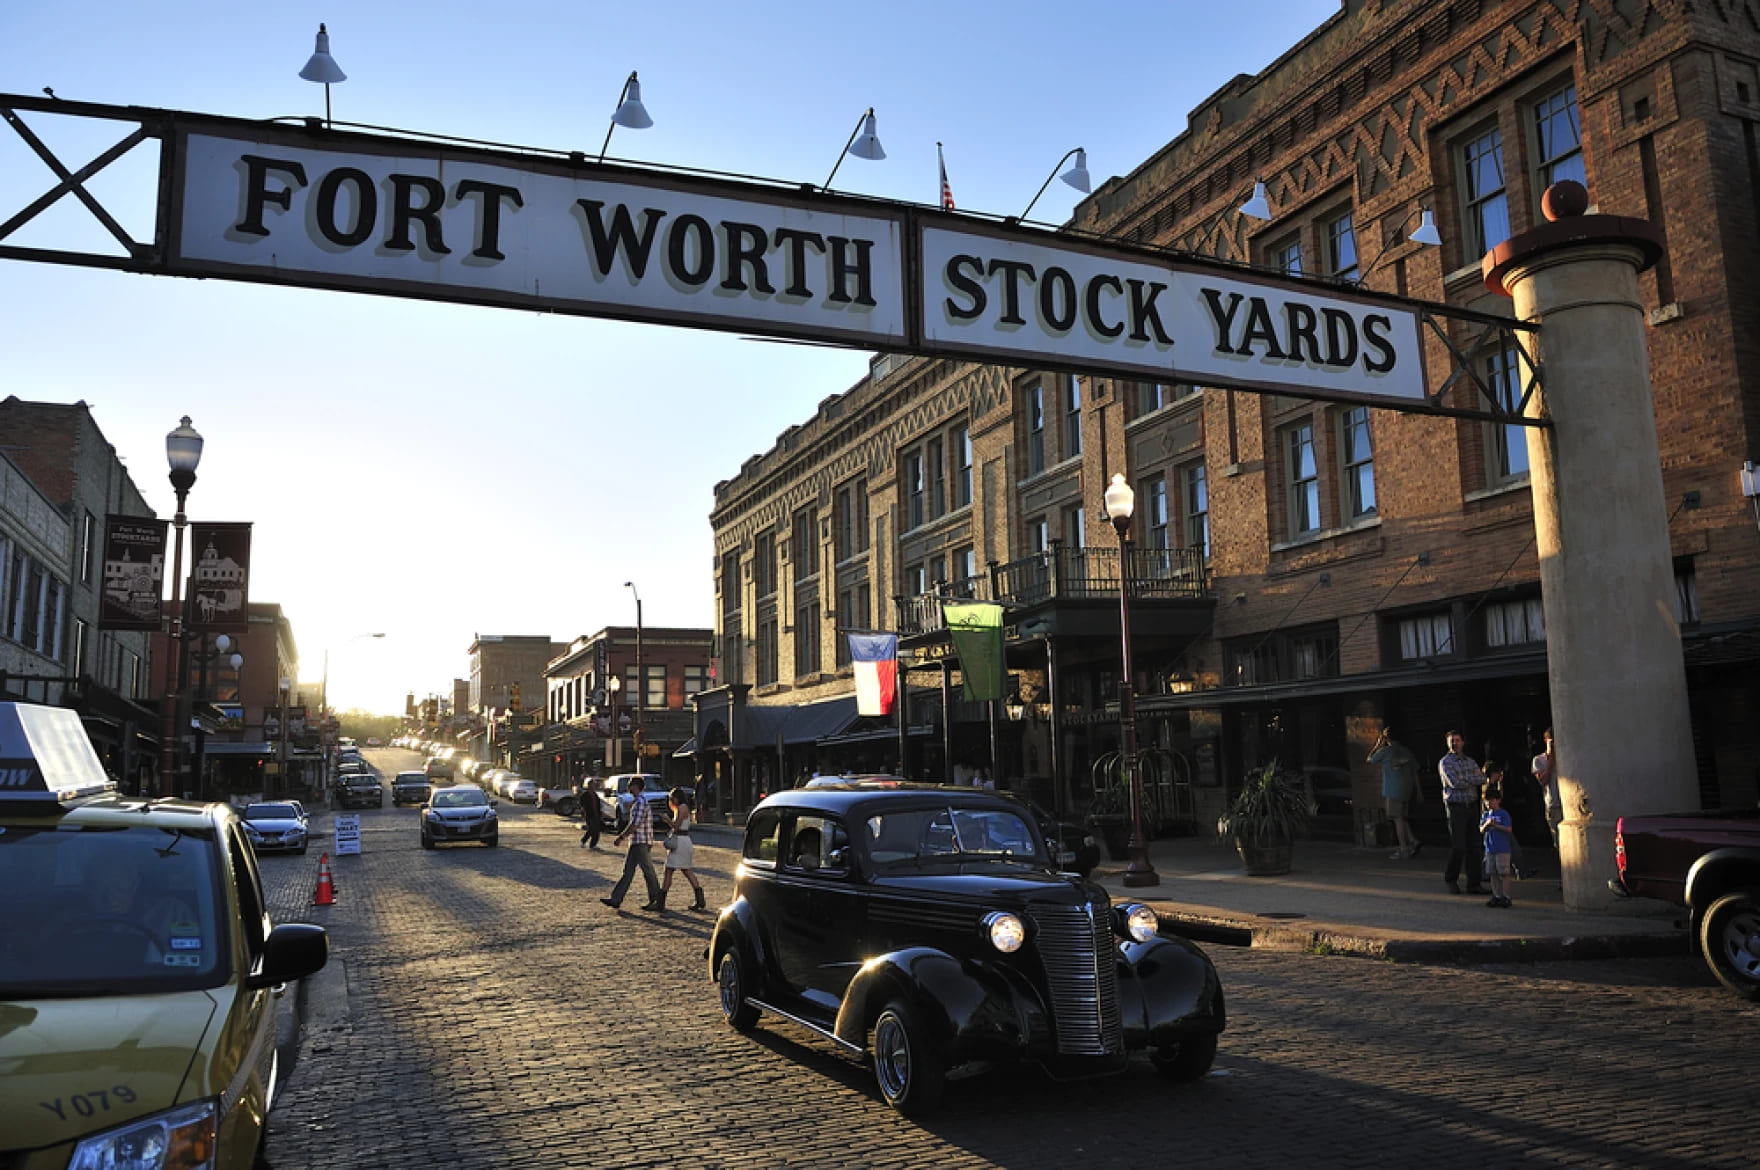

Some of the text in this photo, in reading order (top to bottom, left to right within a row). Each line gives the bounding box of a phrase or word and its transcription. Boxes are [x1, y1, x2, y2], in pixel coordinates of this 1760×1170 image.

[231, 154, 1397, 374] FORT WORTH STOCK YARDS
[38, 1084, 136, 1121] Y079
